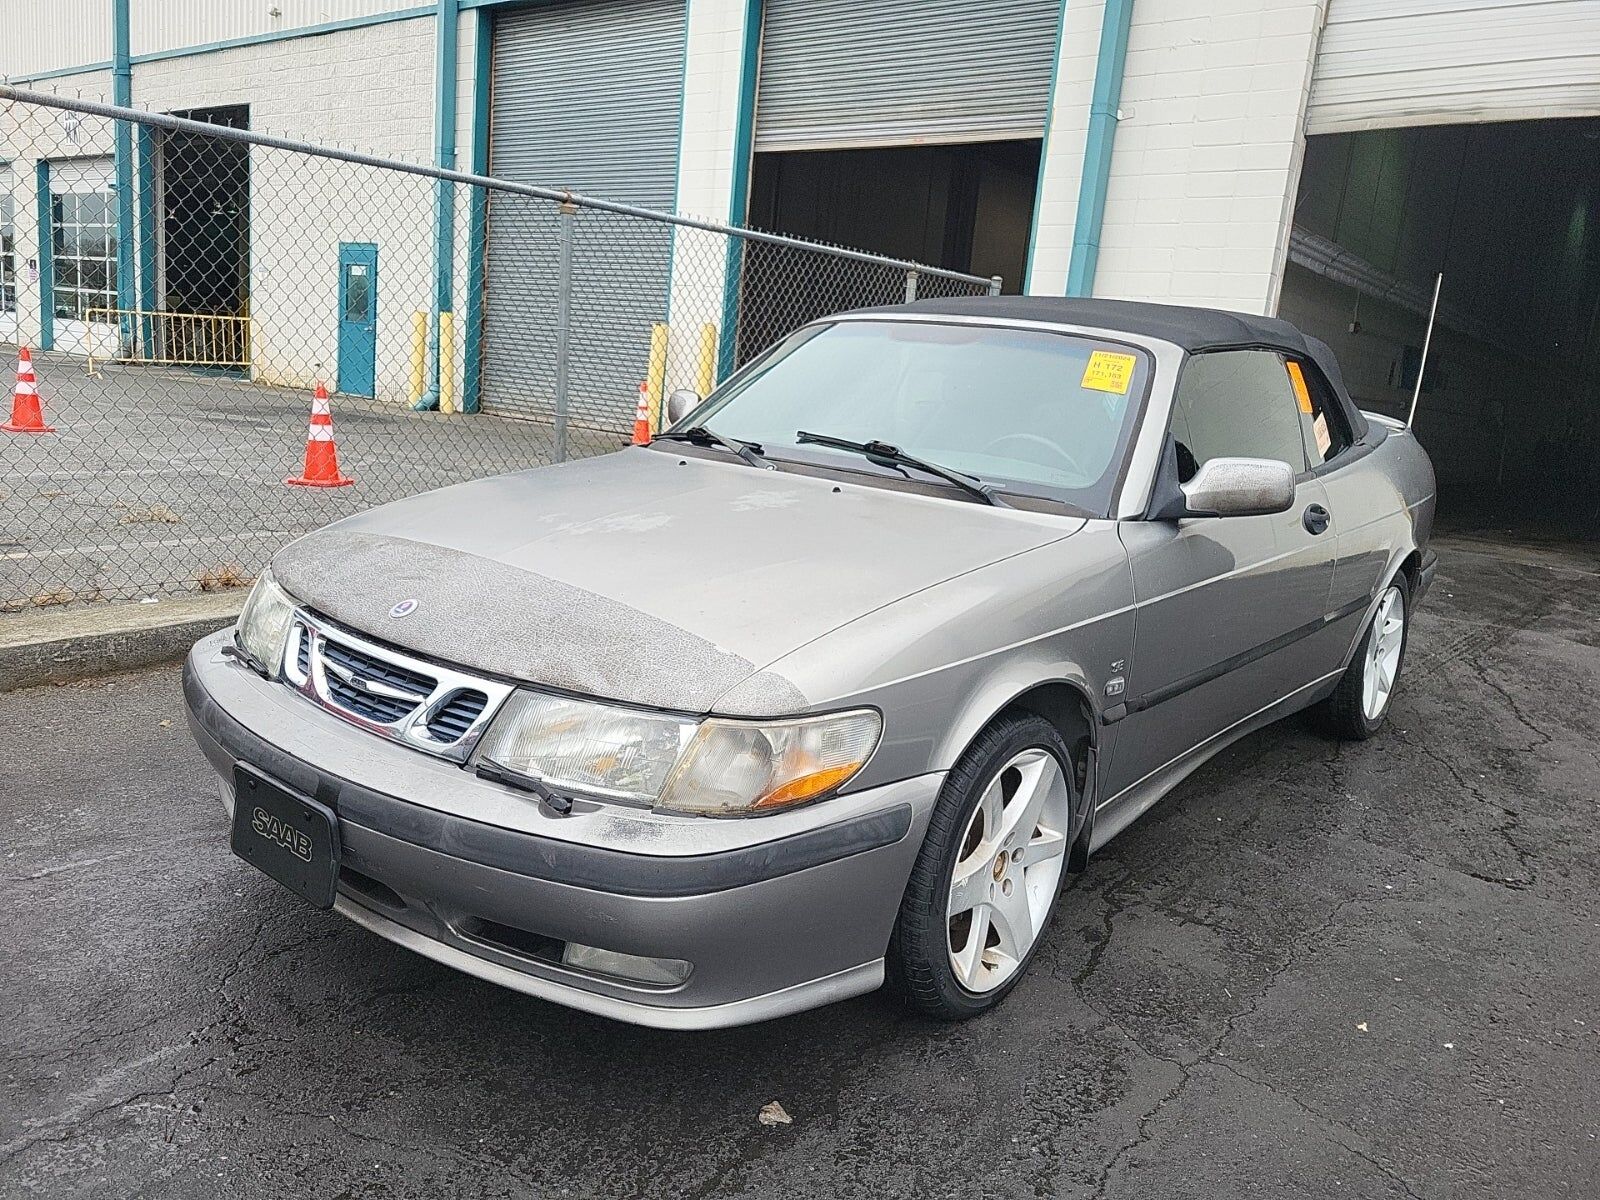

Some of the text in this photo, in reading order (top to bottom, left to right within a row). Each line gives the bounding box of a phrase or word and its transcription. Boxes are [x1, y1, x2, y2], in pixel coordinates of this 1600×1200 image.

[1093, 361, 1101, 369] H
[1105, 363, 1123, 372] 172
[252, 806, 313, 862] SAAB
